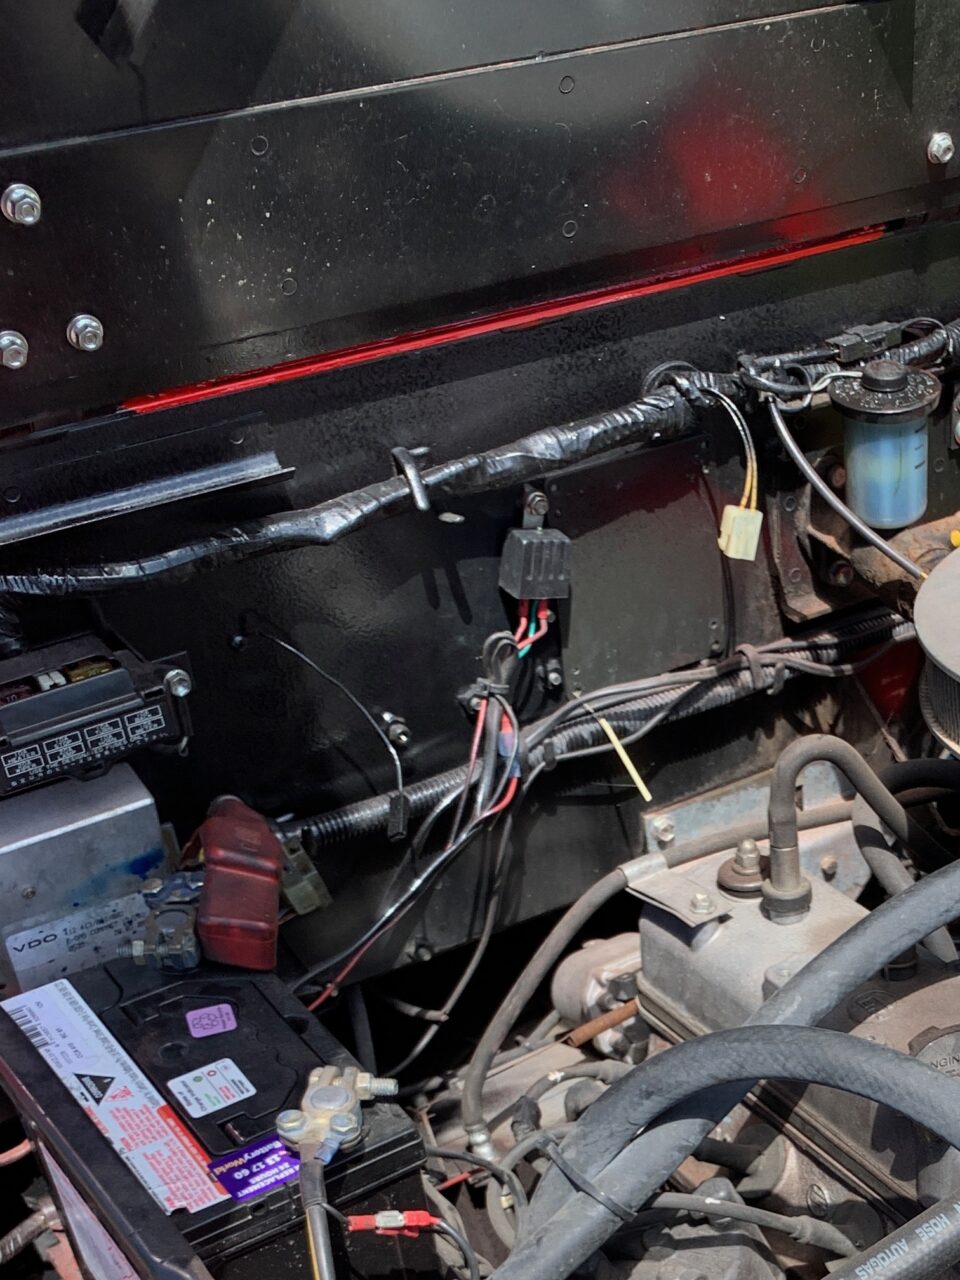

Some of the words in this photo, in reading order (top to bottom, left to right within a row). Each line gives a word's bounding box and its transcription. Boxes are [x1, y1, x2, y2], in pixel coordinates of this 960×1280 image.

[11, 932, 59, 954] VDO
[249, 1160, 266, 1174] 17
[263, 1152, 282, 1167] 13
[232, 1166, 251, 1181] 60
[237, 1166, 295, 1198] REPLACEMENT
[248, 1167, 279, 1185] HOURS
[912, 1209, 952, 1245] HOSE
